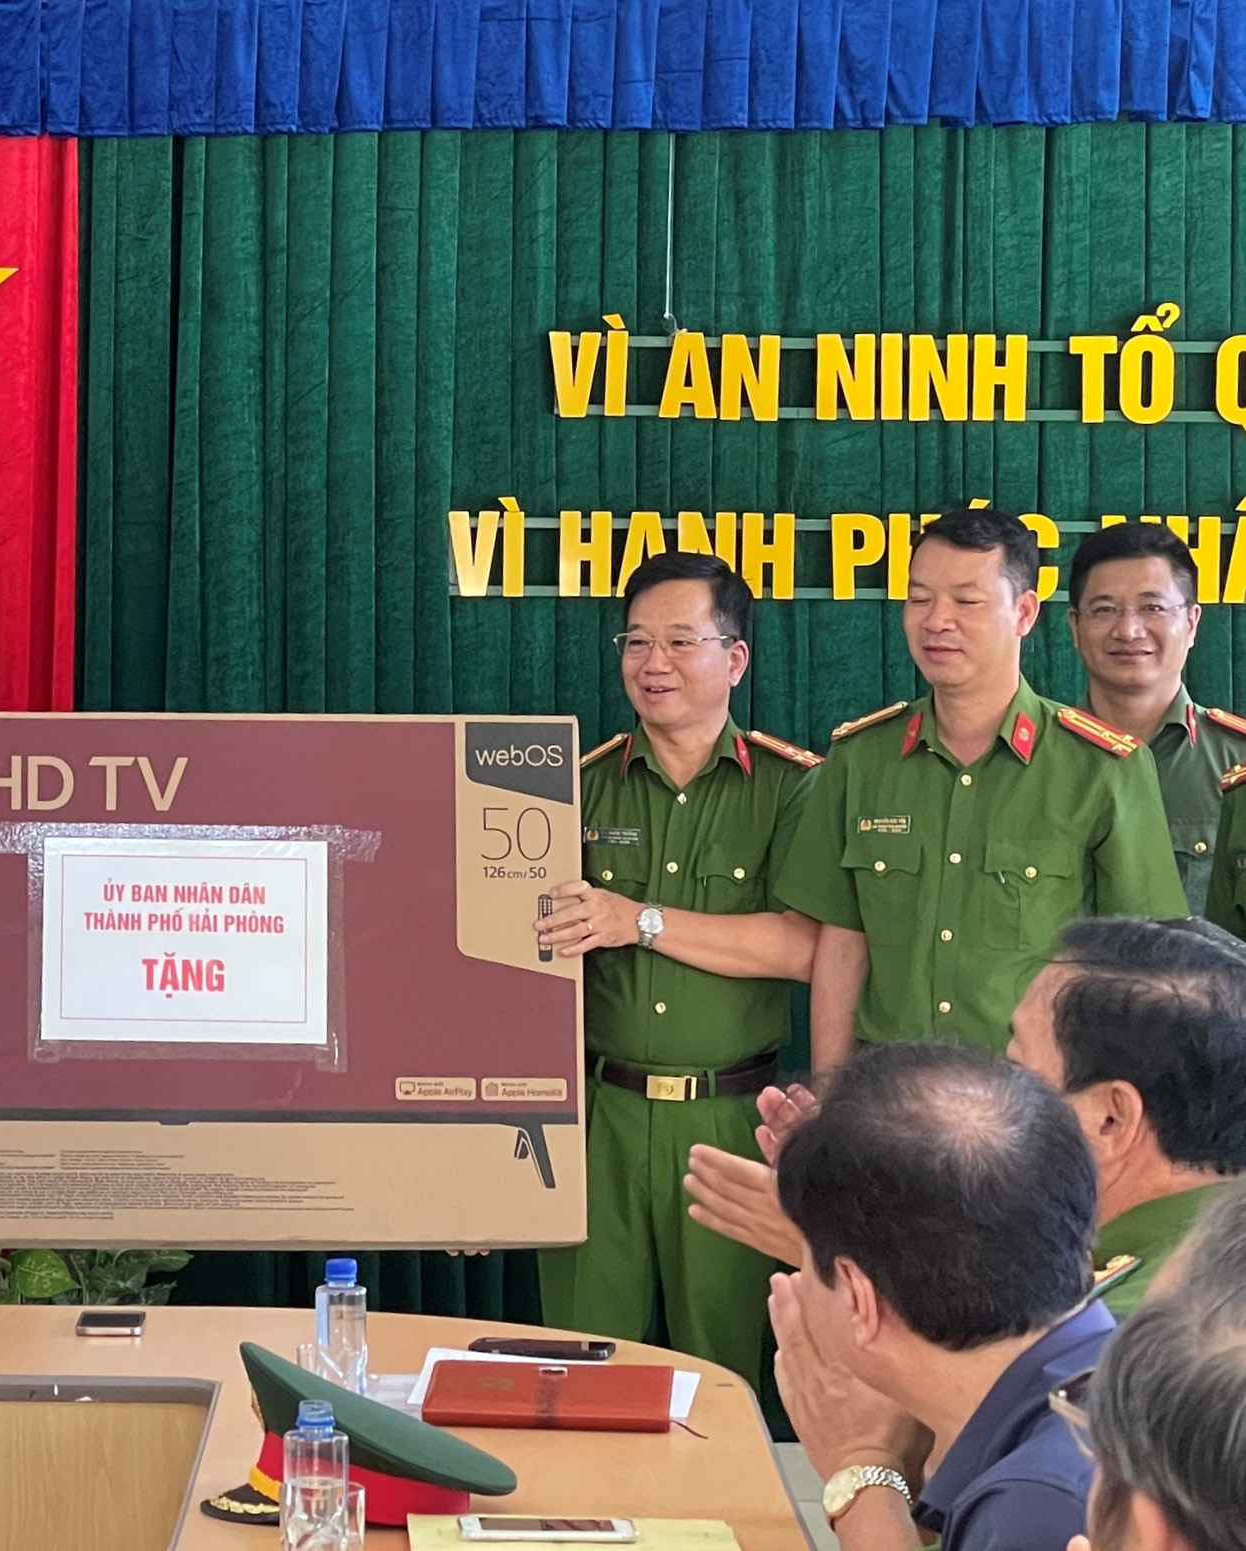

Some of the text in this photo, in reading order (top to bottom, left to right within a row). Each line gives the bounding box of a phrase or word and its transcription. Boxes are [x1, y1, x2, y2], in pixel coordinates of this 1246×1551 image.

[549, 313, 629, 418] VÌ
[658, 331, 781, 422] AN
[816, 333, 1029, 422] NINH
[1069, 302, 1181, 425] TỔ
[448, 496, 525, 598] VÌ
[474, 744, 564, 767] webOS
[88, 756, 189, 812] TV
[480, 807, 552, 862] 50
[103, 878, 266, 904] ỦY BAN NHÂN DÂN
[84, 907, 285, 934] THÀNH PHỐ HẢI PHÒNG
[141, 952, 226, 999] TẶNG
[417, 1087, 473, 1098] Apple AirPlay
[501, 1088, 525, 1098] Apple
